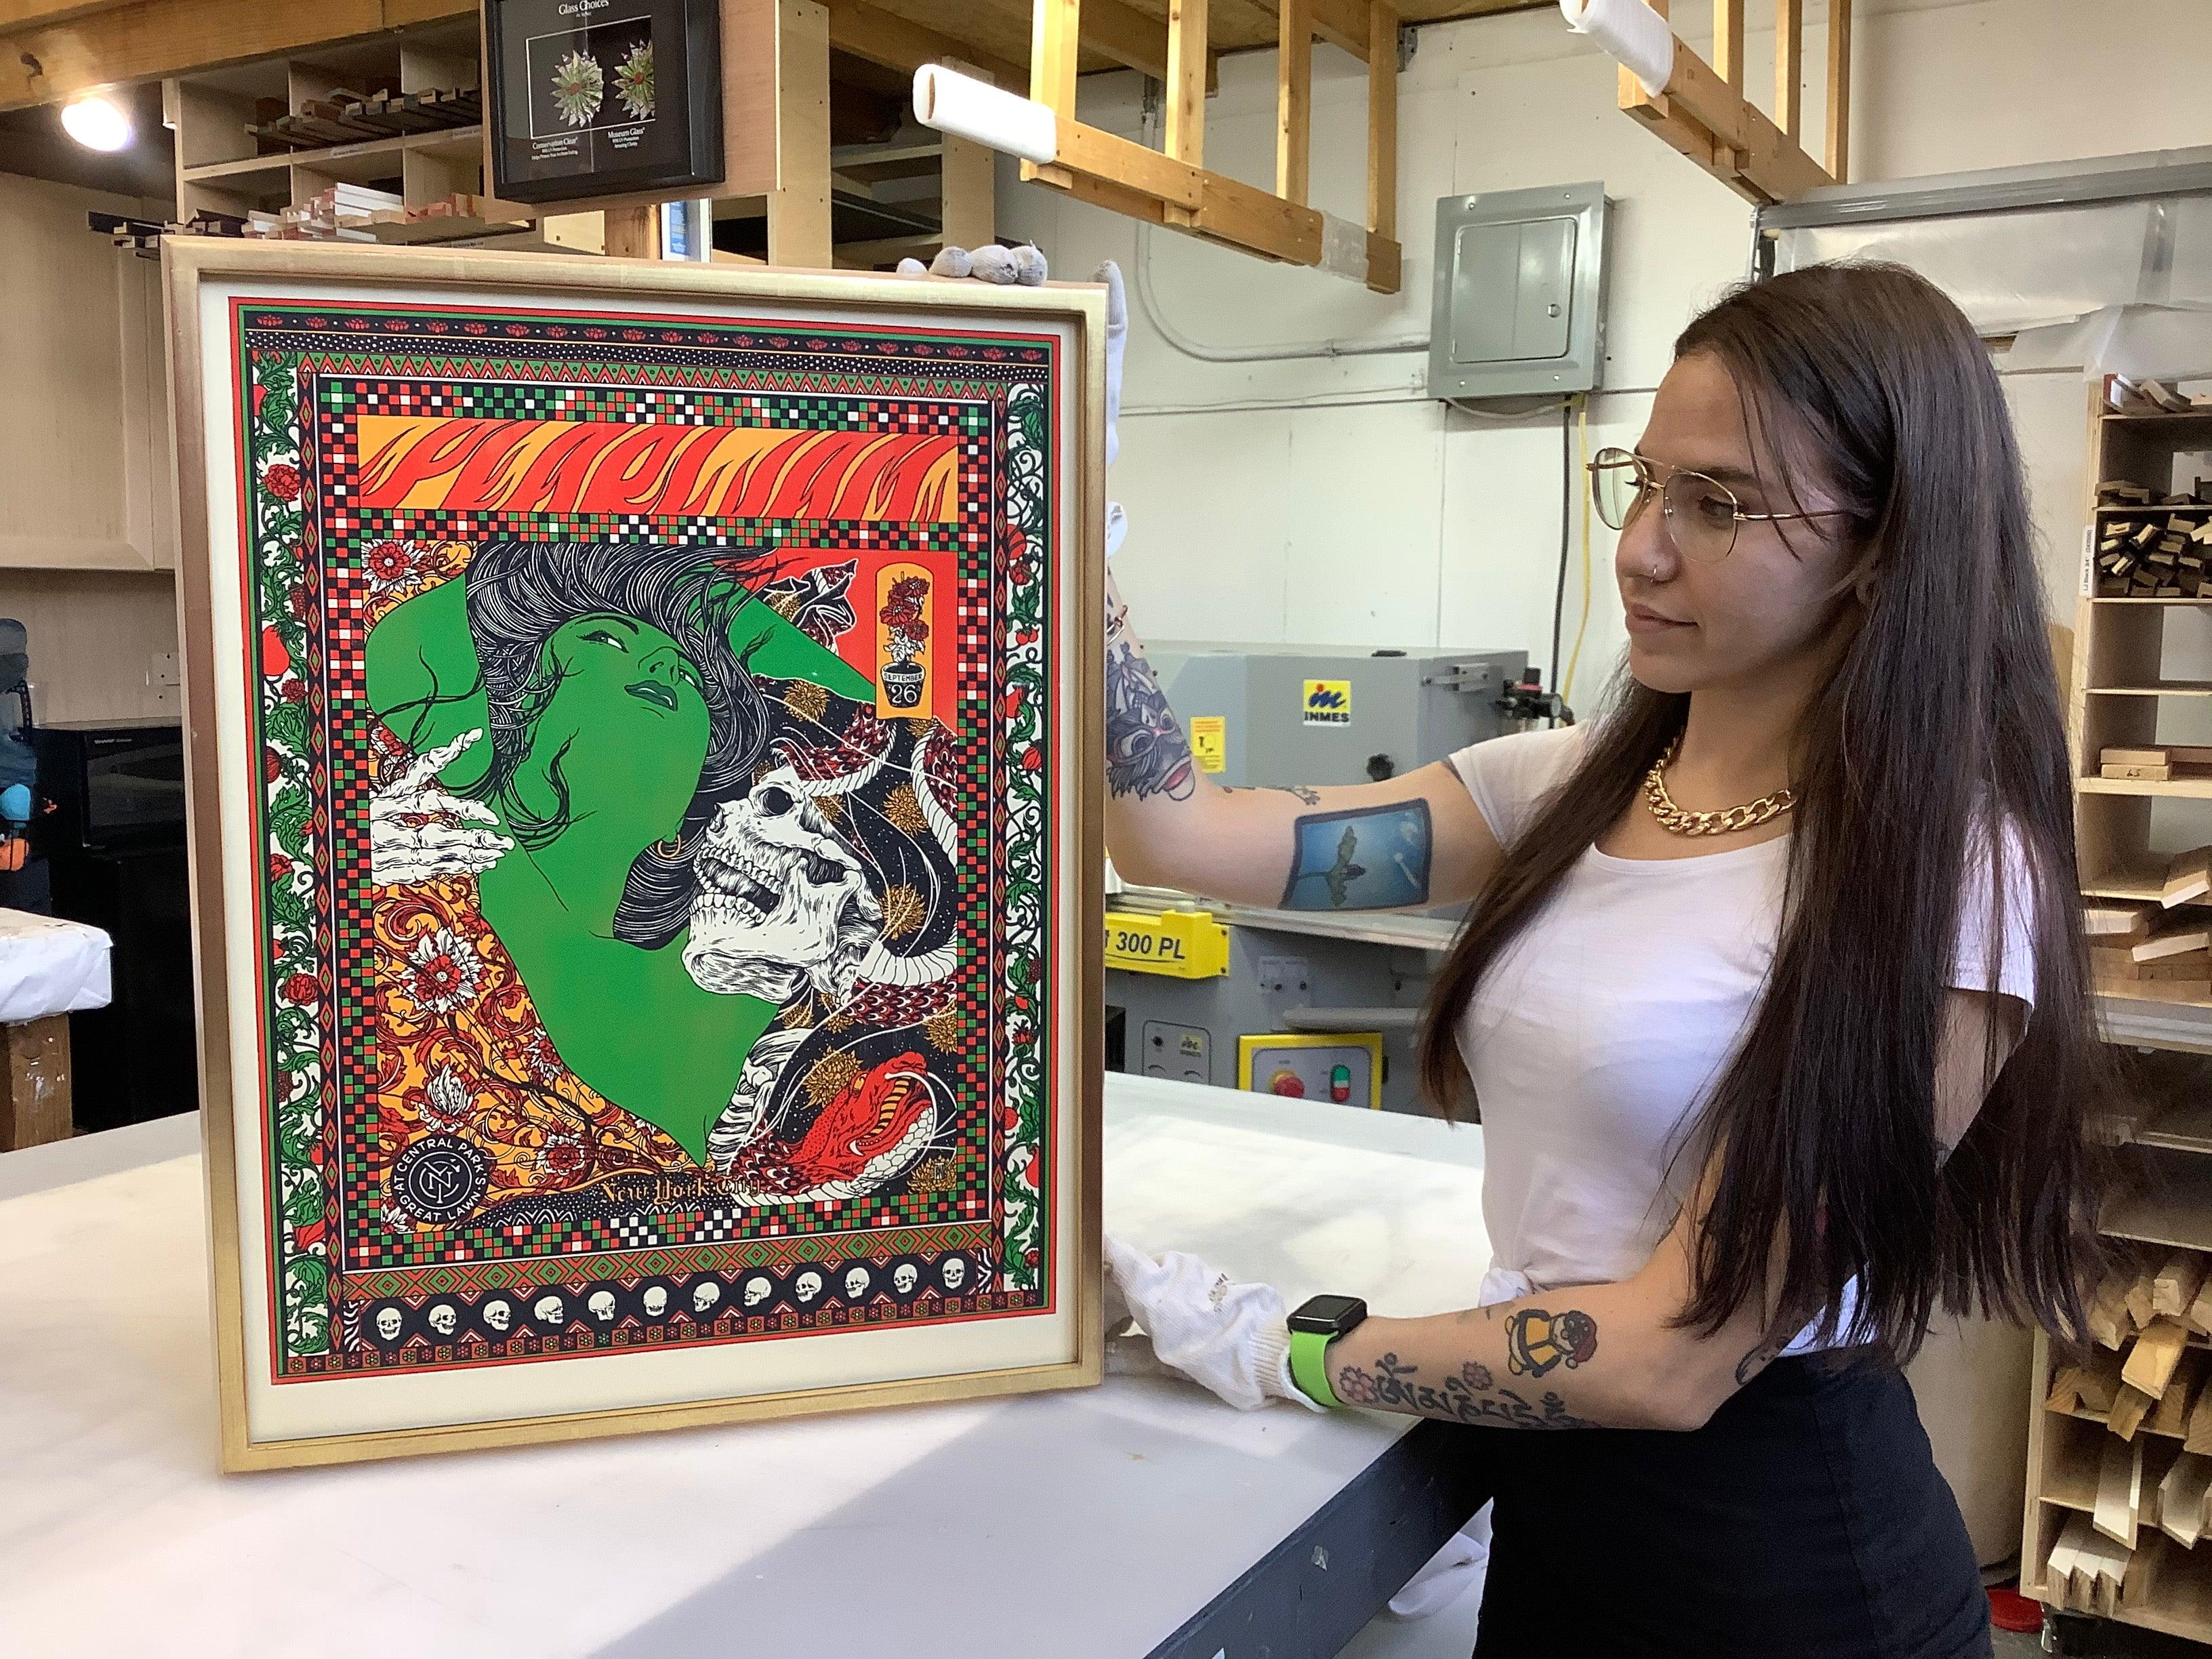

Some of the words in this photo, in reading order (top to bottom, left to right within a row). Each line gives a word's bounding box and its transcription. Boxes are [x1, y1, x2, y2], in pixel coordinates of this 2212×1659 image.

[558, 4, 579, 15] Glass
[579, 0, 609, 11] Choices
[884, 672, 922, 682] SEPTEMBER
[891, 684, 918, 703] 26
[1304, 711, 1350, 722] INMES
[1115, 931, 1152, 954] 300
[1158, 937, 1185, 960] PL
[396, 1137, 453, 1172] CENTRAL
[457, 1142, 488, 1186] PARK'S
[394, 1175, 405, 1191] AT
[600, 1182, 647, 1203] New
[653, 1177, 710, 1206] York
[400, 1195, 442, 1222] GREAT
[447, 1191, 481, 1221] LAWN
